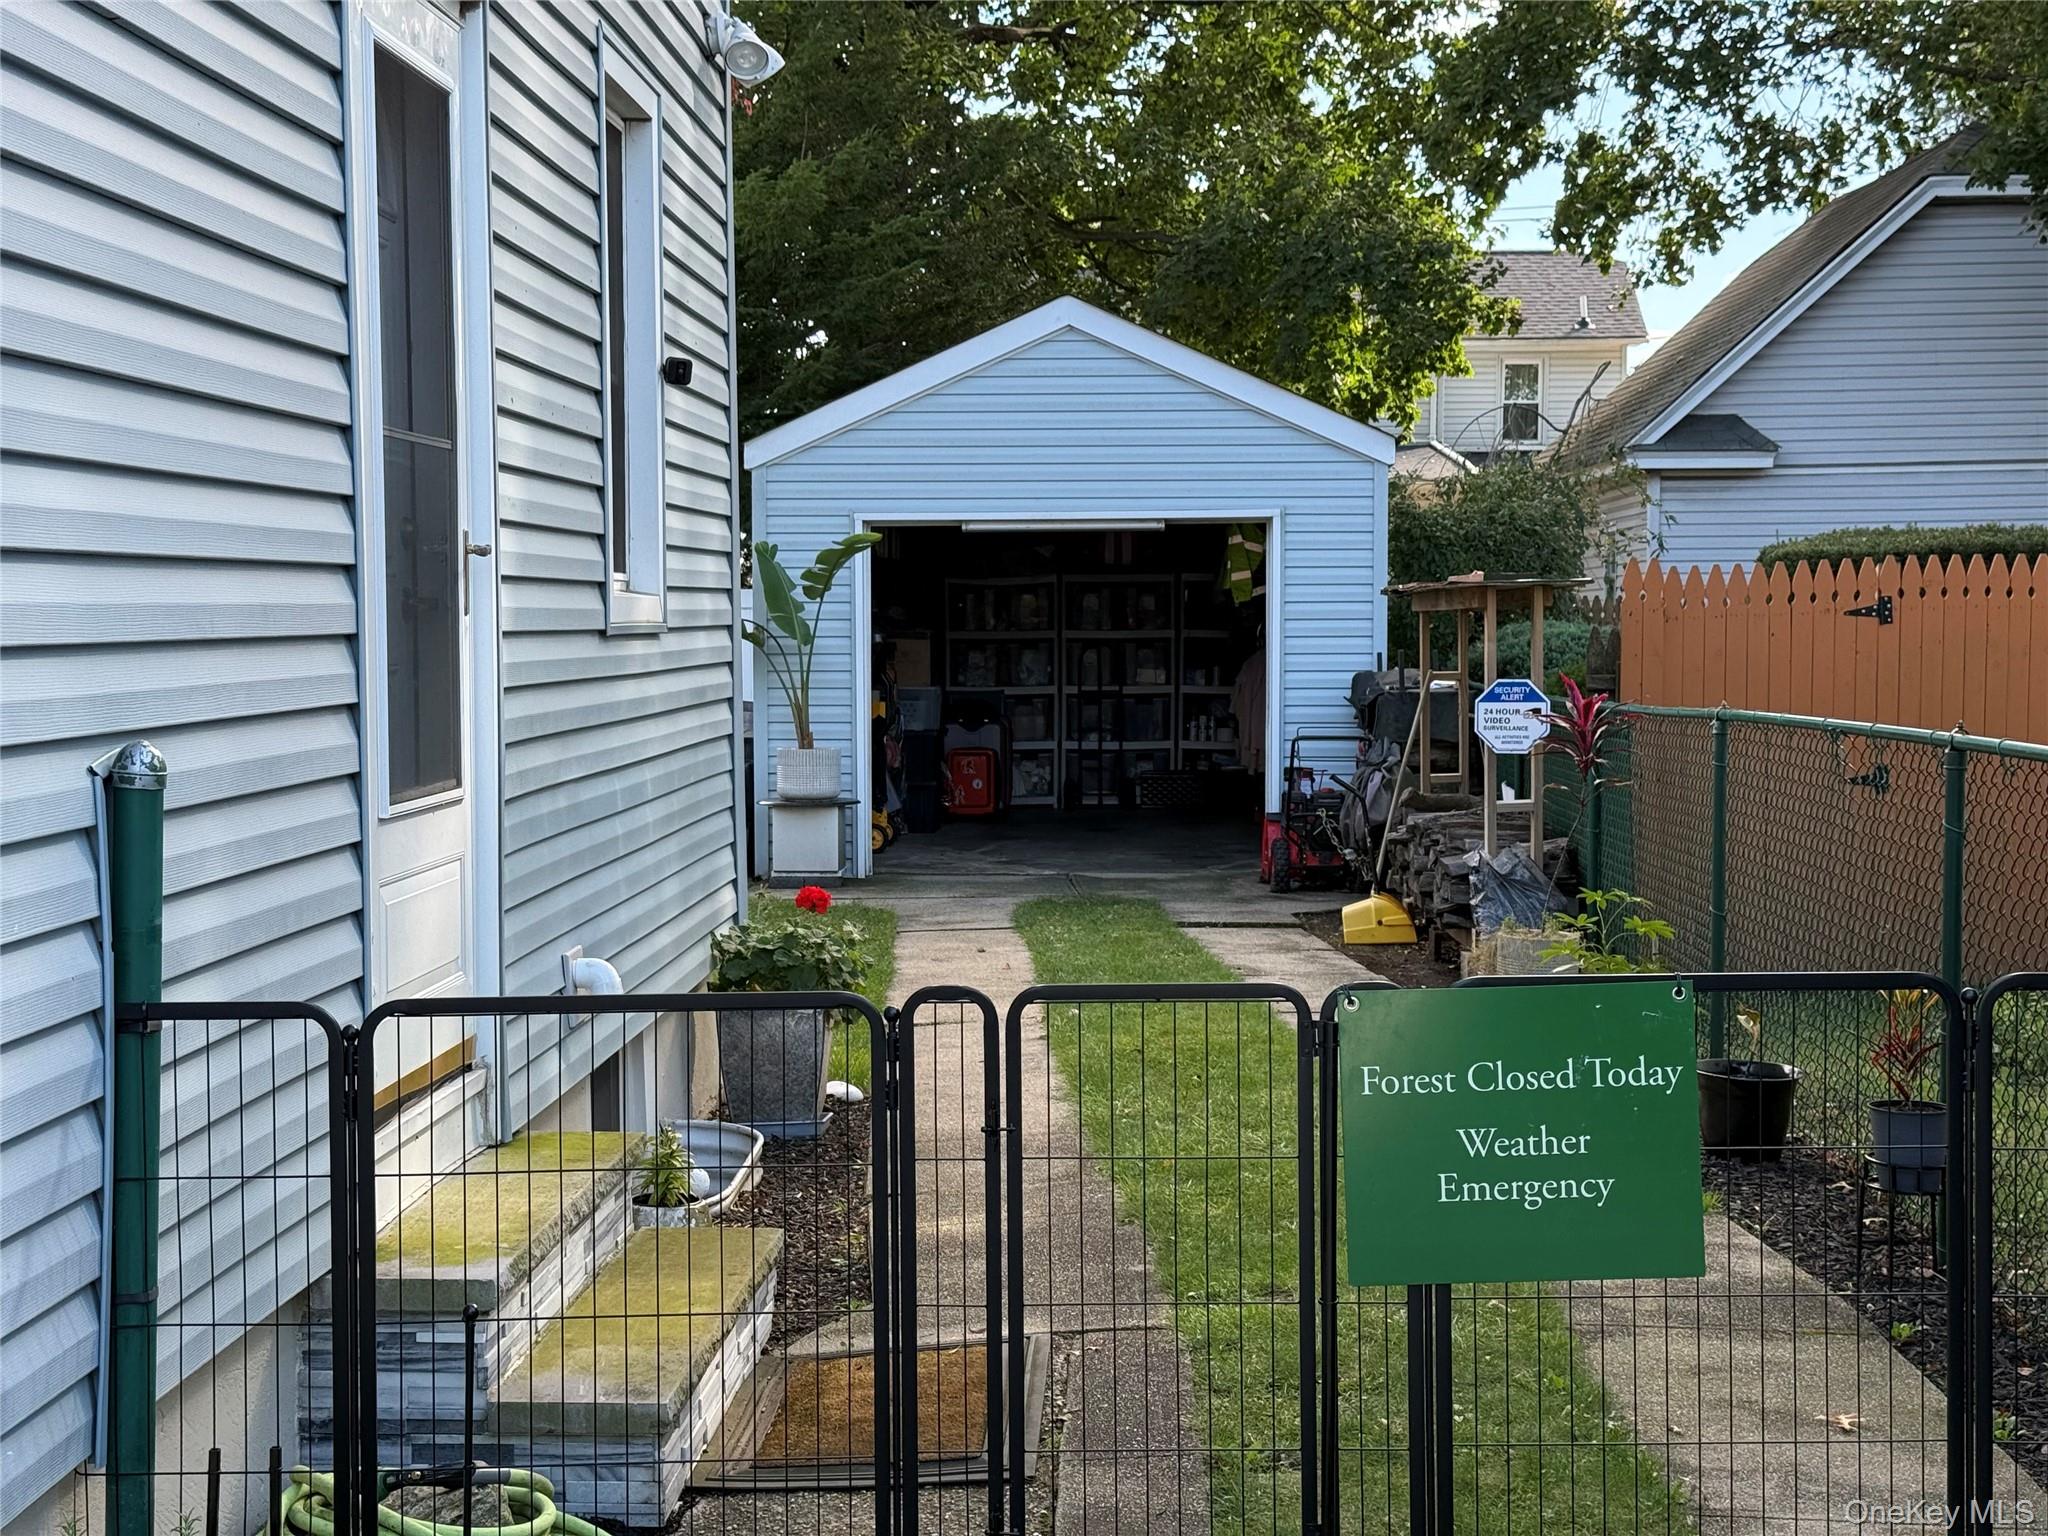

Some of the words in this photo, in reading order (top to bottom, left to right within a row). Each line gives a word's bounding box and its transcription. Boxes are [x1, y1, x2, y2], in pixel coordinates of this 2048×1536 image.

[1494, 686, 1531, 694] SECURITY
[1495, 708, 1521, 716] HOUR
[1360, 1065, 1457, 1096] Forest
[1467, 1058, 1576, 1092] Closed
[1583, 1055, 1684, 1095] Today
[1456, 1124, 1591, 1158] Weather
[1437, 1172, 1616, 1211] Emergency
